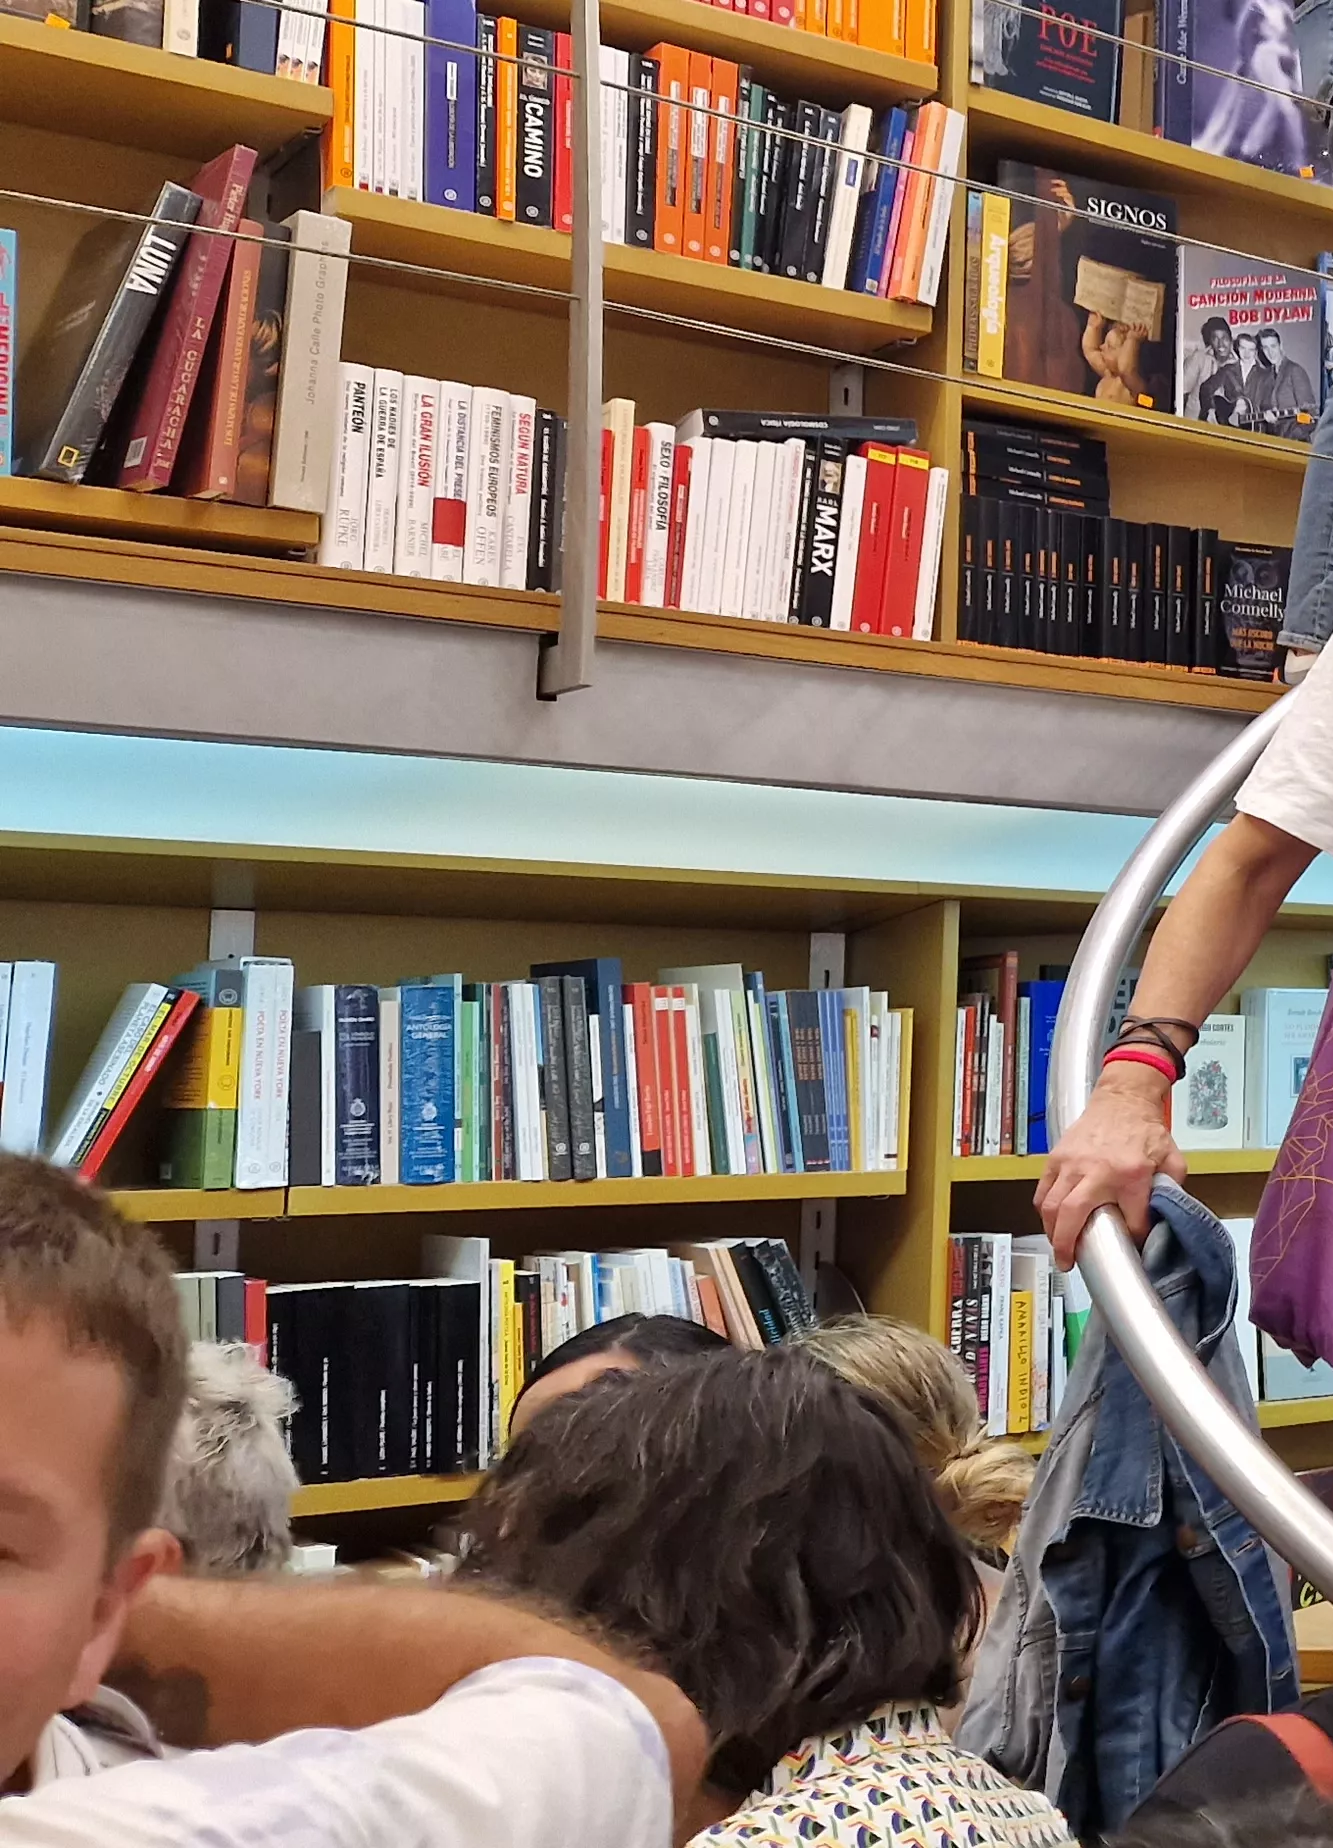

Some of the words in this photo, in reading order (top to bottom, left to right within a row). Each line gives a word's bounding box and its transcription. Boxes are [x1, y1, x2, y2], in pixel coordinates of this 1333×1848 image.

[523, 102, 544, 178] CAMINO
[1087, 196, 1168, 231] SIGNOS
[126, 234, 177, 294] LUNA
[314, 294, 324, 324] Photo
[1189, 289, 1249, 309] CANCIÓN
[1254, 287, 1318, 303] MODERNA
[1229, 308, 1260, 325] BOB
[1263, 305, 1314, 324] DYLAN
[190, 315, 205, 340] LA
[309, 326, 320, 355] Calle
[304, 359, 318, 404] Johanna
[352, 381, 366, 433] PANTEÓN
[421, 395, 434, 409] LA
[457, 400, 467, 410] LA
[377, 434, 385, 445] DE
[387, 438, 396, 448] DE
[419, 412, 433, 441] GRAN
[455, 412, 466, 452] DISTANCIA
[489, 405, 502, 464] FEMINISMOS
[417, 444, 433, 487] ILUSIÓN
[454, 455, 464, 471] DEL
[660, 440, 671, 468] SEXO
[515, 452, 530, 494] NATURA
[486, 466, 498, 517] EUROPEOS
[656, 475, 668, 531] FILOSOFÍA
[475, 526, 486, 565] OFFEN
[811, 504, 838, 577] MARX
[1220, 601, 1285, 621] Connelly
[1224, 584, 1282, 602] Michael
[950, 1299, 962, 1355] GUERRA
[1015, 1300, 1027, 1365] AMARILLO
[1018, 1373, 1028, 1410] INDIO
